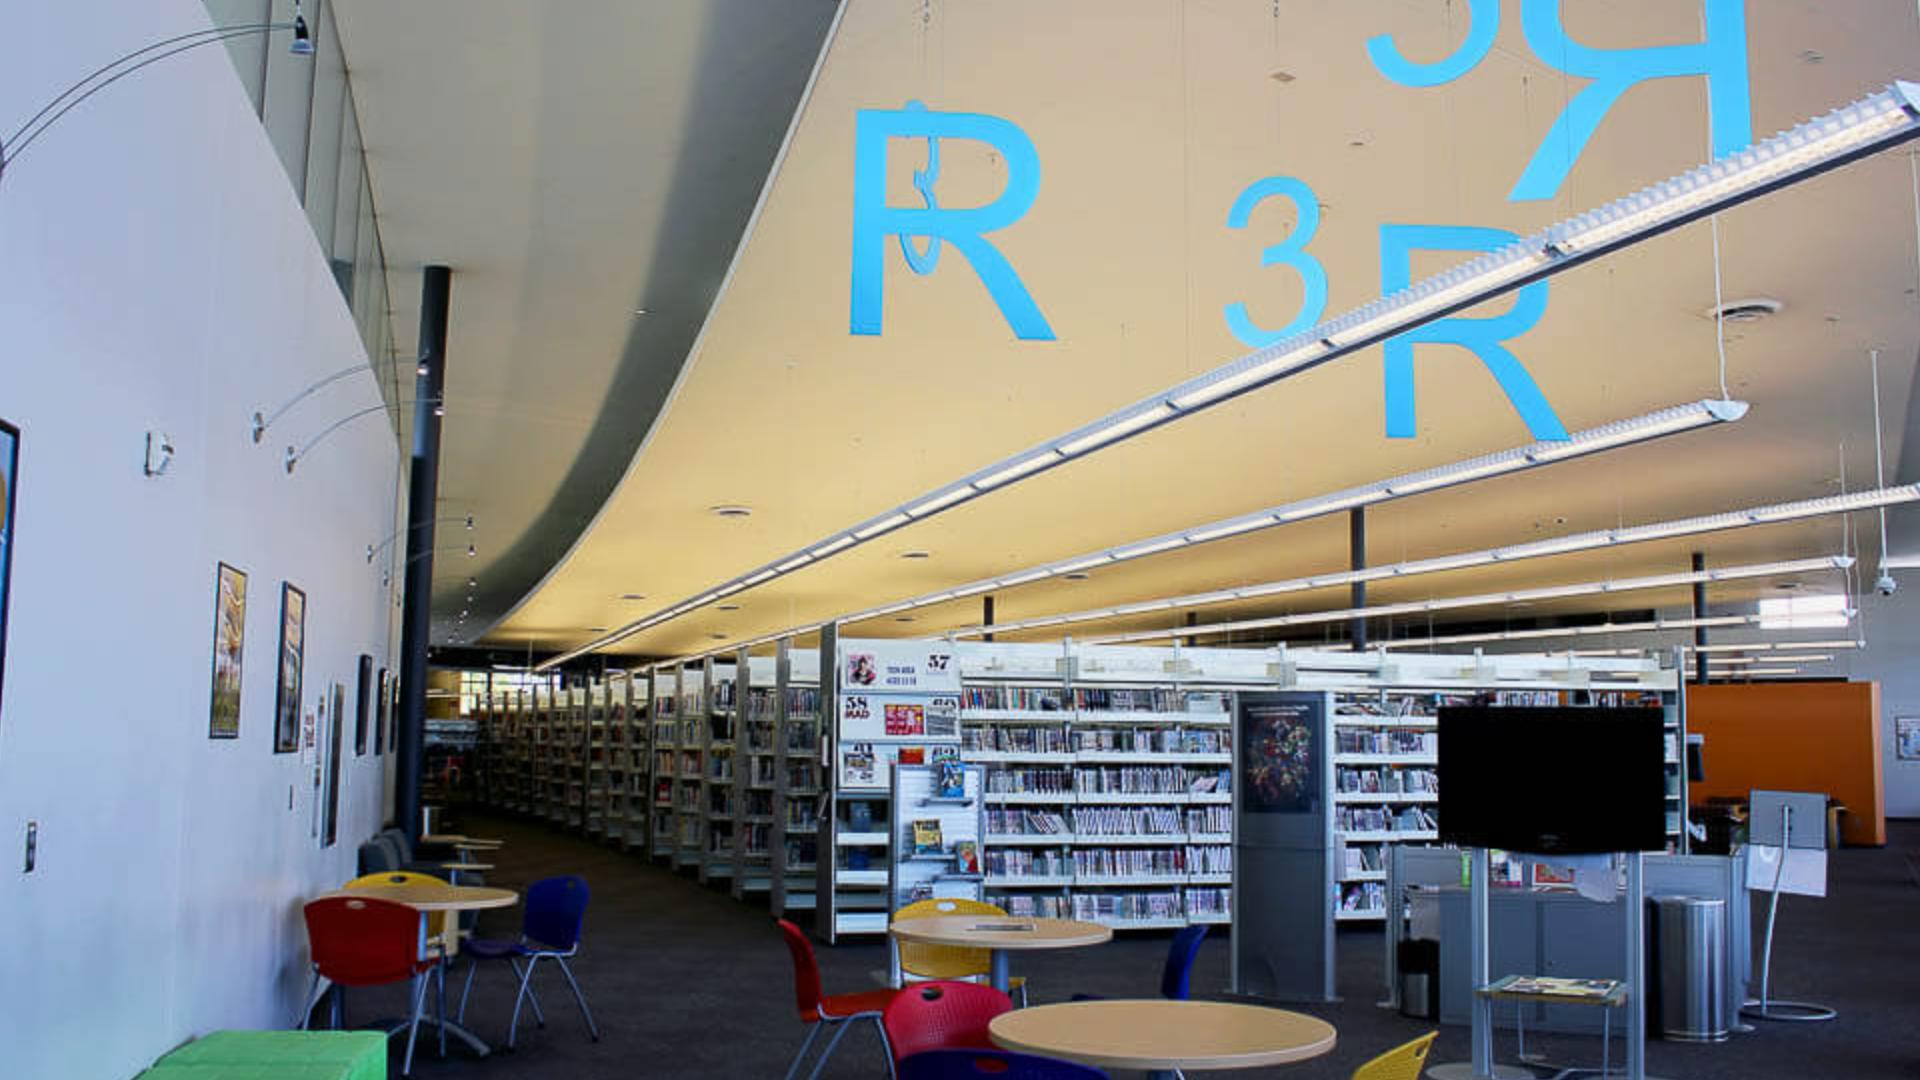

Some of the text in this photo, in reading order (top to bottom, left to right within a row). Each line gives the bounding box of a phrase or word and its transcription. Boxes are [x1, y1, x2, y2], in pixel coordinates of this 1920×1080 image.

[850, 109, 1056, 341] R
[1223, 176, 1328, 349] 3
[1379, 224, 1571, 441] R
